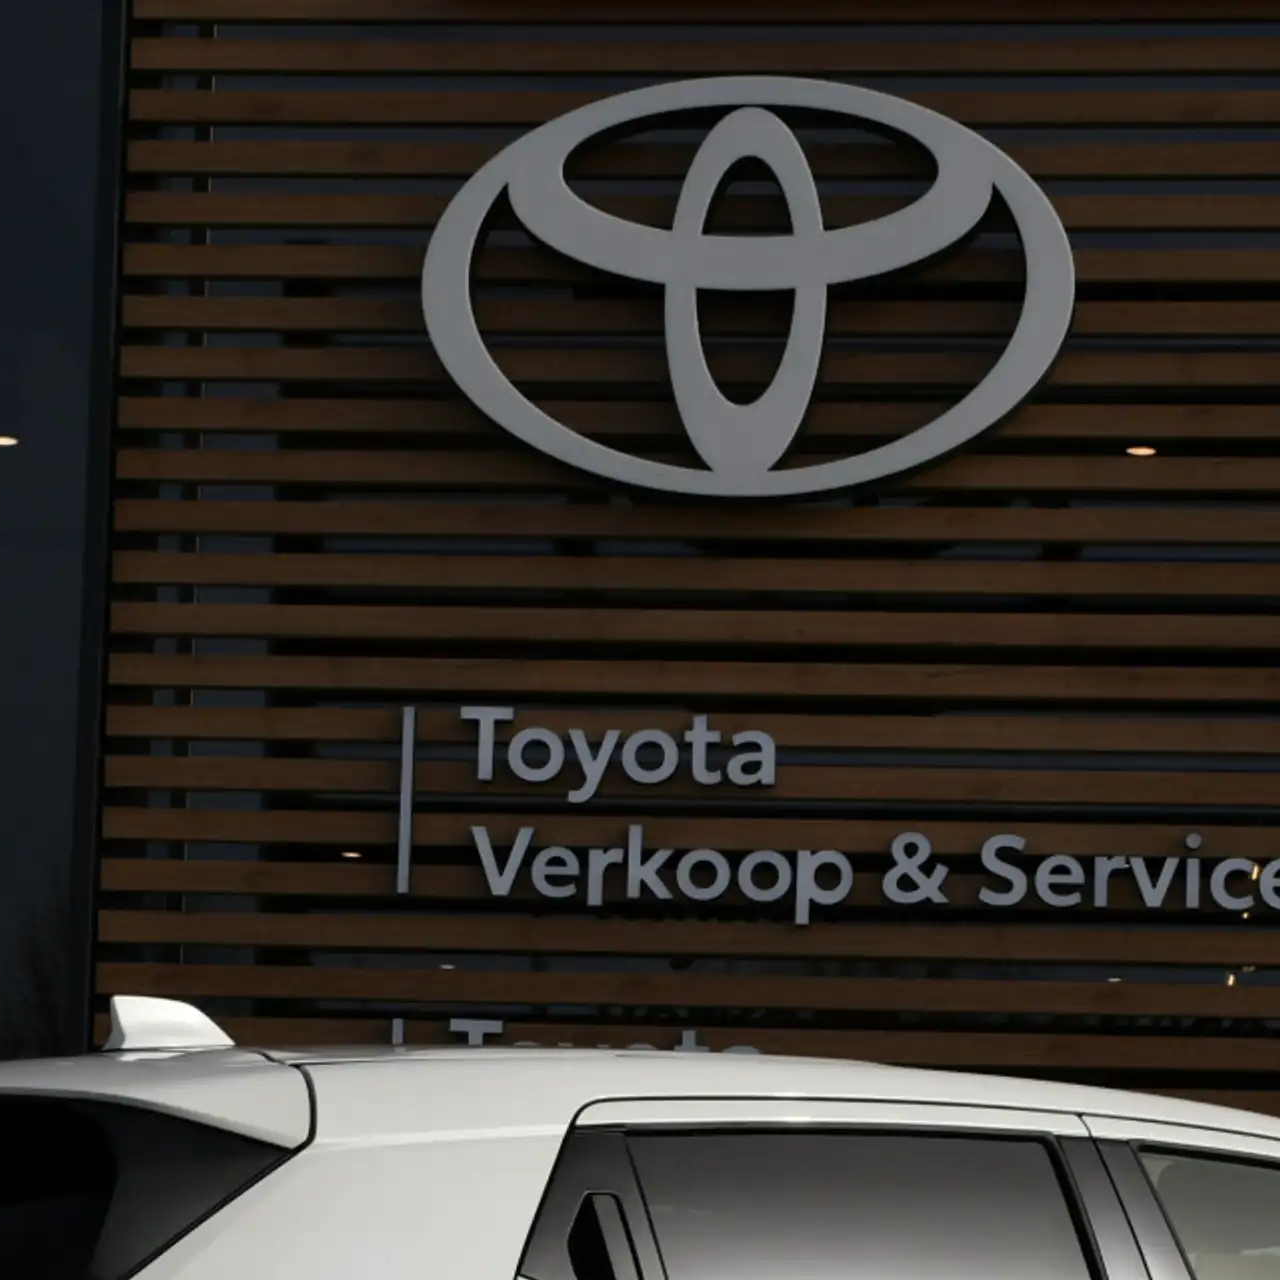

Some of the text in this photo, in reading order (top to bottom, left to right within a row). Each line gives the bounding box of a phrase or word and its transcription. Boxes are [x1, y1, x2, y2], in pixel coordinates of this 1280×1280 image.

[460, 706, 777, 804] Toyota
[470, 824, 854, 926] Verkoop
[882, 832, 949, 904] &
